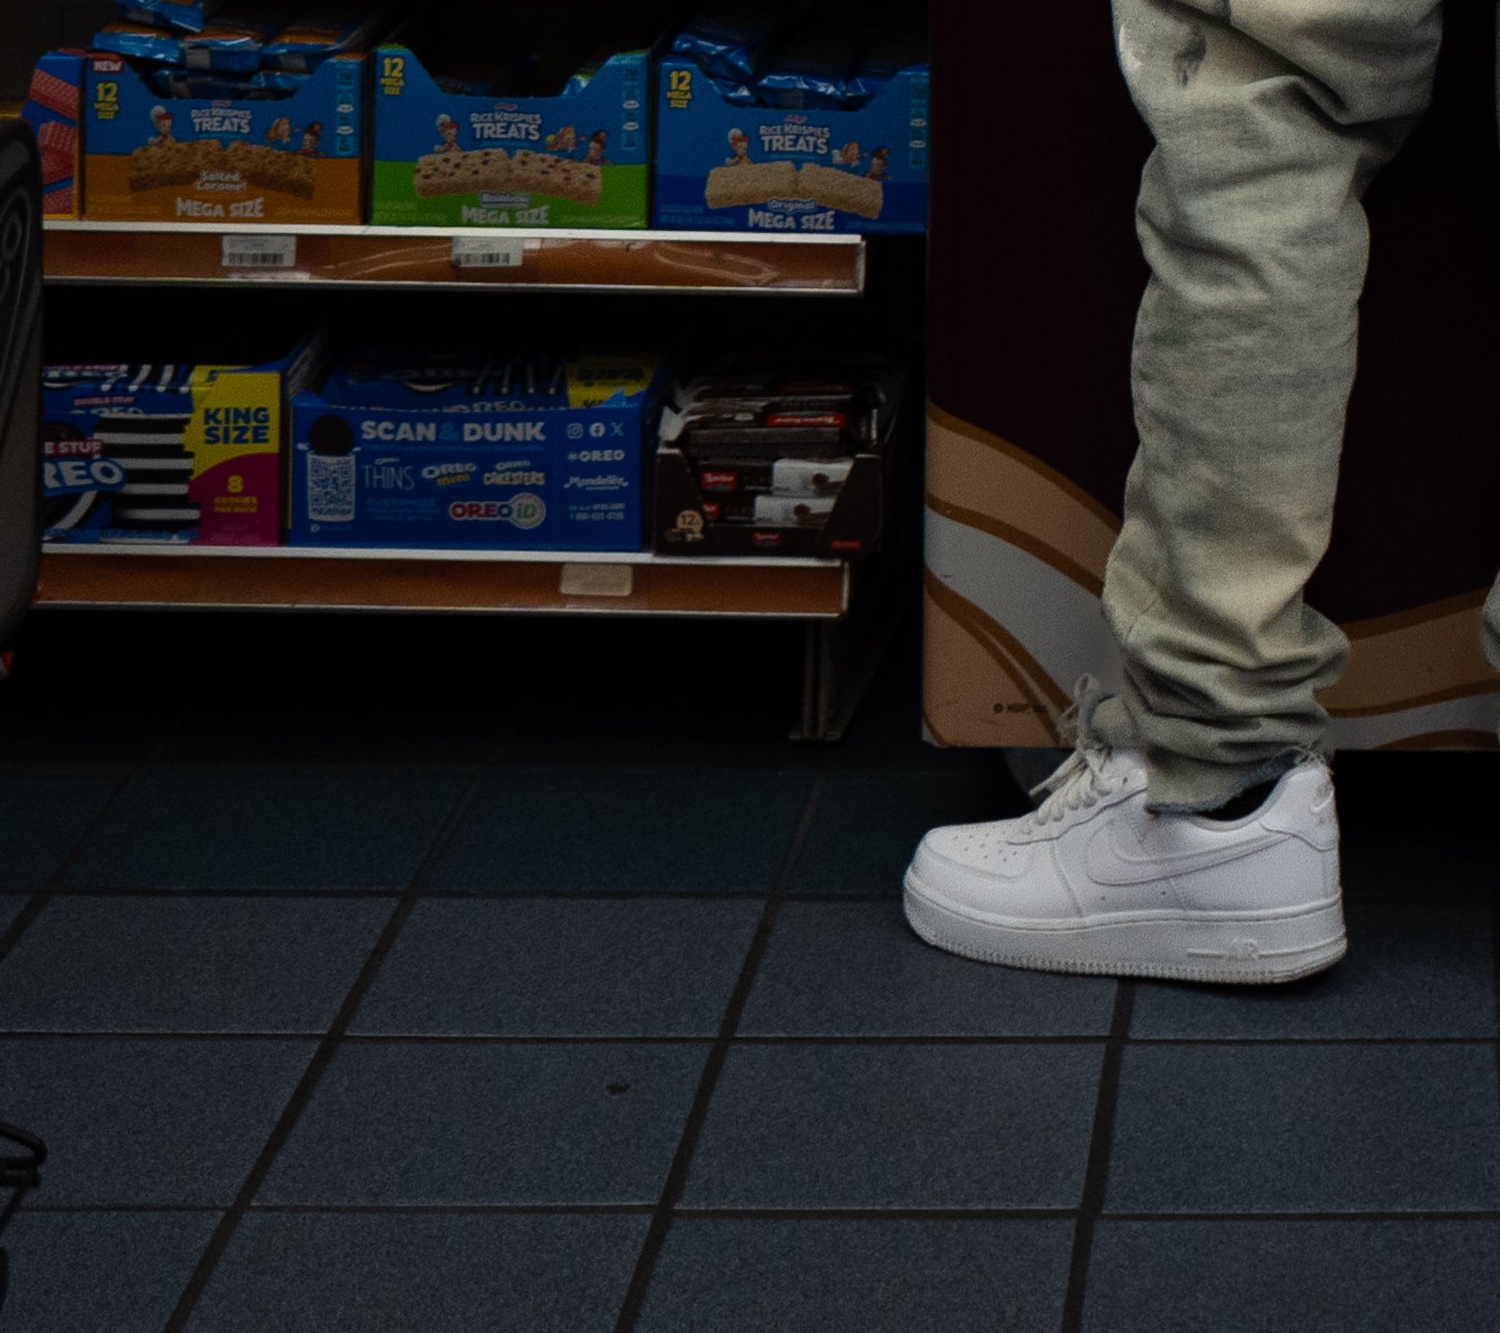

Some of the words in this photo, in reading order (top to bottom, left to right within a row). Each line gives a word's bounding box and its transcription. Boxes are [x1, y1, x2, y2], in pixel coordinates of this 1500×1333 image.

[669, 70, 691, 91] 12
[95, 82, 117, 102] 12
[191, 109, 212, 120] RICE
[193, 117, 251, 133] TREATS
[472, 122, 541, 141] TREATS
[759, 125, 784, 137] RICE
[784, 124, 830, 139] KRISPIES
[761, 135, 828, 154] TREATS
[176, 197, 224, 218] MEGA
[230, 197, 264, 218] SIZE
[767, 198, 815, 212] Original
[748, 209, 797, 229] MEGA
[801, 210, 836, 231] SIZE
[203, 407, 270, 426] KING
[204, 425, 270, 444] SIZE
[360, 422, 437, 443] SCAN
[463, 421, 546, 443] DUNK
[363, 465, 415, 490] THINS
